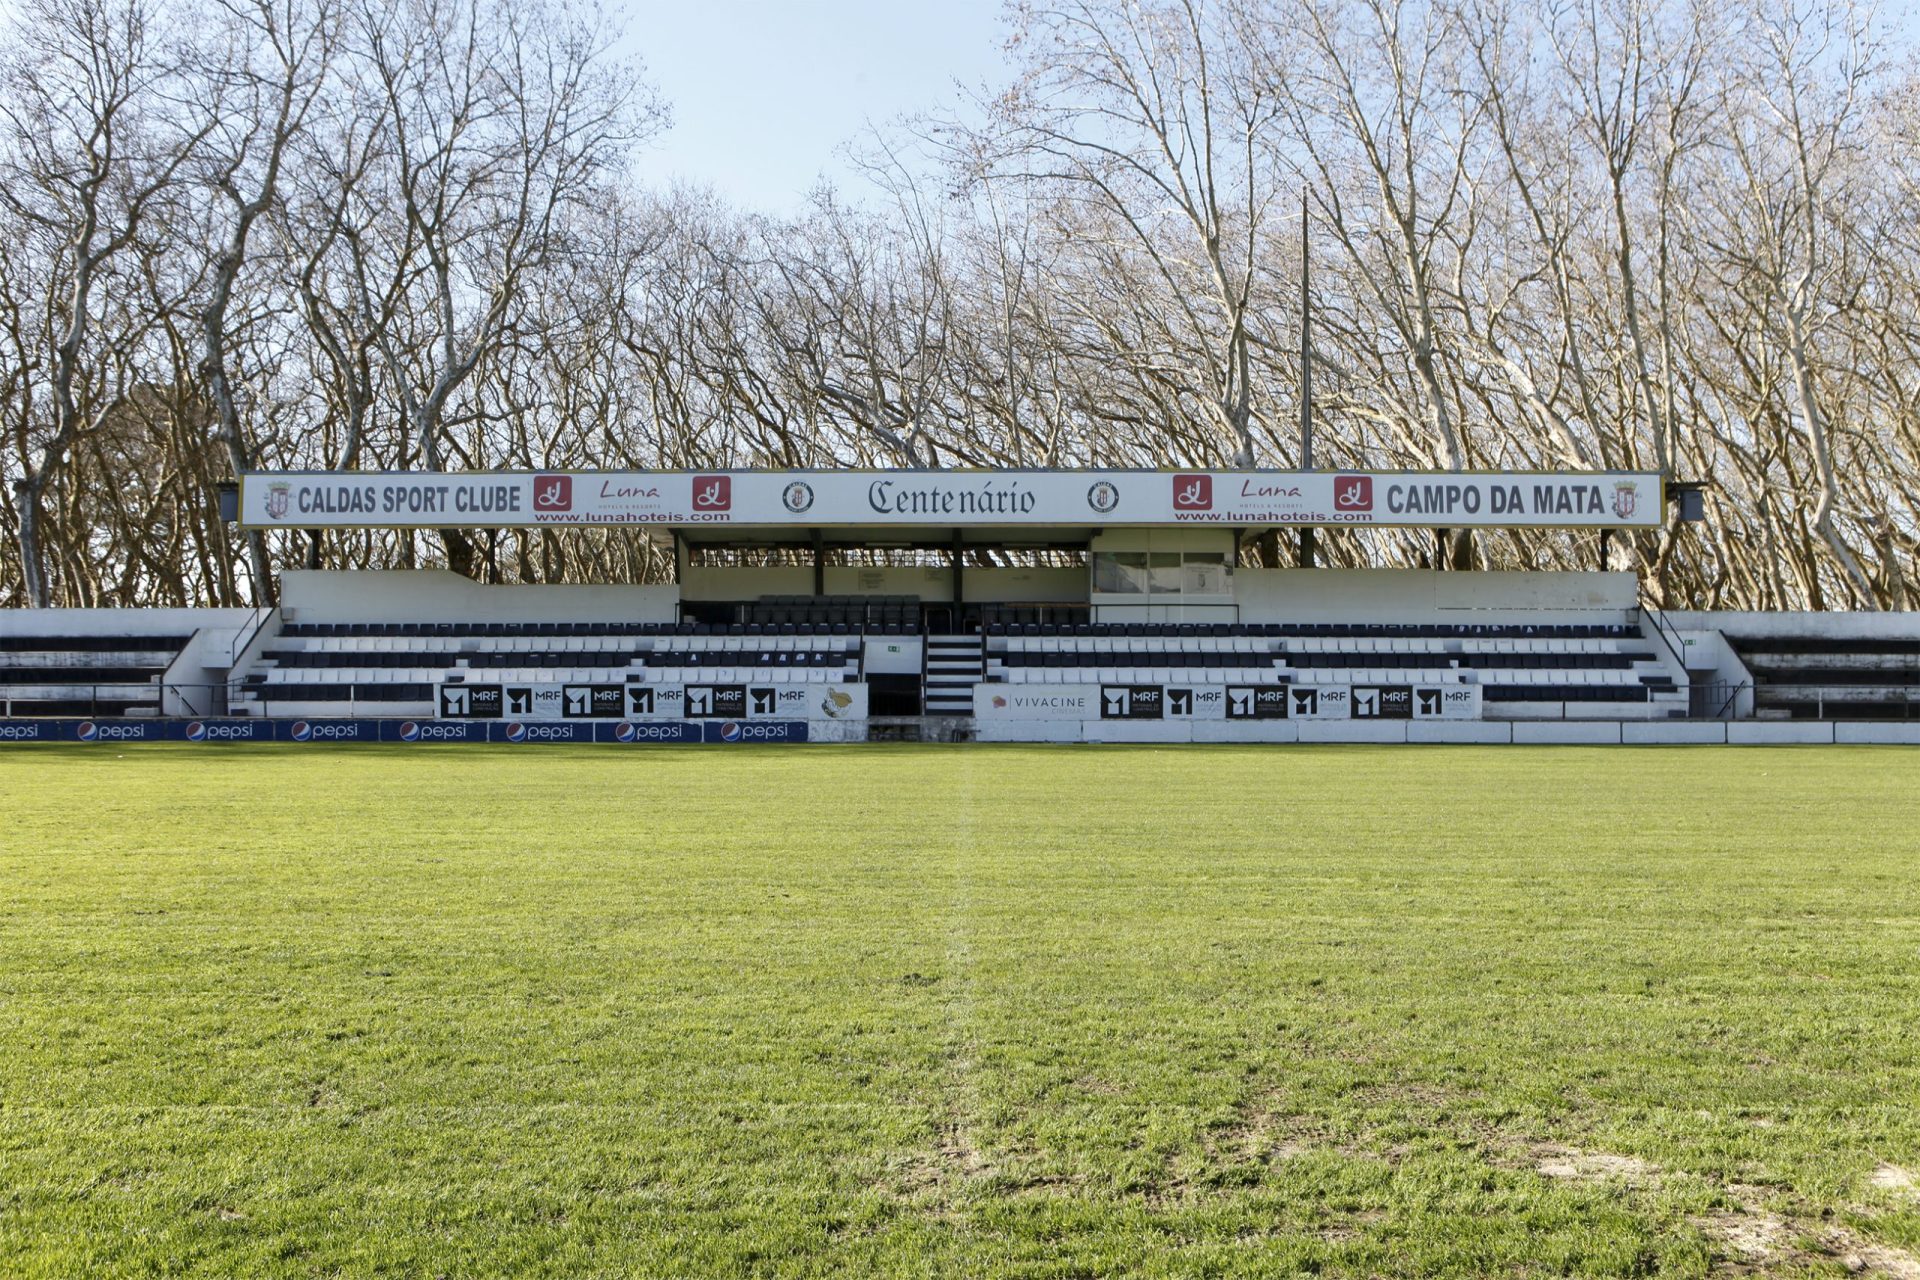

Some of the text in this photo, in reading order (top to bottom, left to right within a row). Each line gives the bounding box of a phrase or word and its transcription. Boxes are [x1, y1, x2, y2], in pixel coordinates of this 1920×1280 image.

[600, 480, 660, 498] Luna
[1241, 479, 1302, 497] Luna
[298, 486, 520, 513] CALDAS SPORT CLUBE
[869, 480, 1036, 515] Centenário
[1387, 486, 1606, 514] CAMPO DA MATA
[534, 512, 731, 522] www.lunahoteis.com
[1175, 511, 1373, 522] www.lunahoteis.com
[472, 691, 499, 701] MRF
[535, 691, 561, 701] MRF
[594, 691, 621, 701] MRF
[657, 691, 683, 701] MRF
[715, 691, 742, 701] MRF
[779, 691, 805, 701] MRF
[1132, 692, 1159, 702] MRF
[1196, 692, 1222, 702] MRF
[1257, 692, 1284, 702] MRF
[1320, 692, 1347, 702] MRF
[1382, 692, 1409, 702] MRF
[1445, 692, 1471, 702] MRF
[1015, 697, 1085, 707] VIVACINE
[99, 724, 144, 739] pepsi
[208, 724, 253, 739] pepsi
[313, 724, 358, 739] pepsi
[421, 724, 467, 739] pepsi
[528, 724, 573, 739] pepsi
[637, 724, 682, 739] pepsi
[743, 724, 788, 739] pepsi
